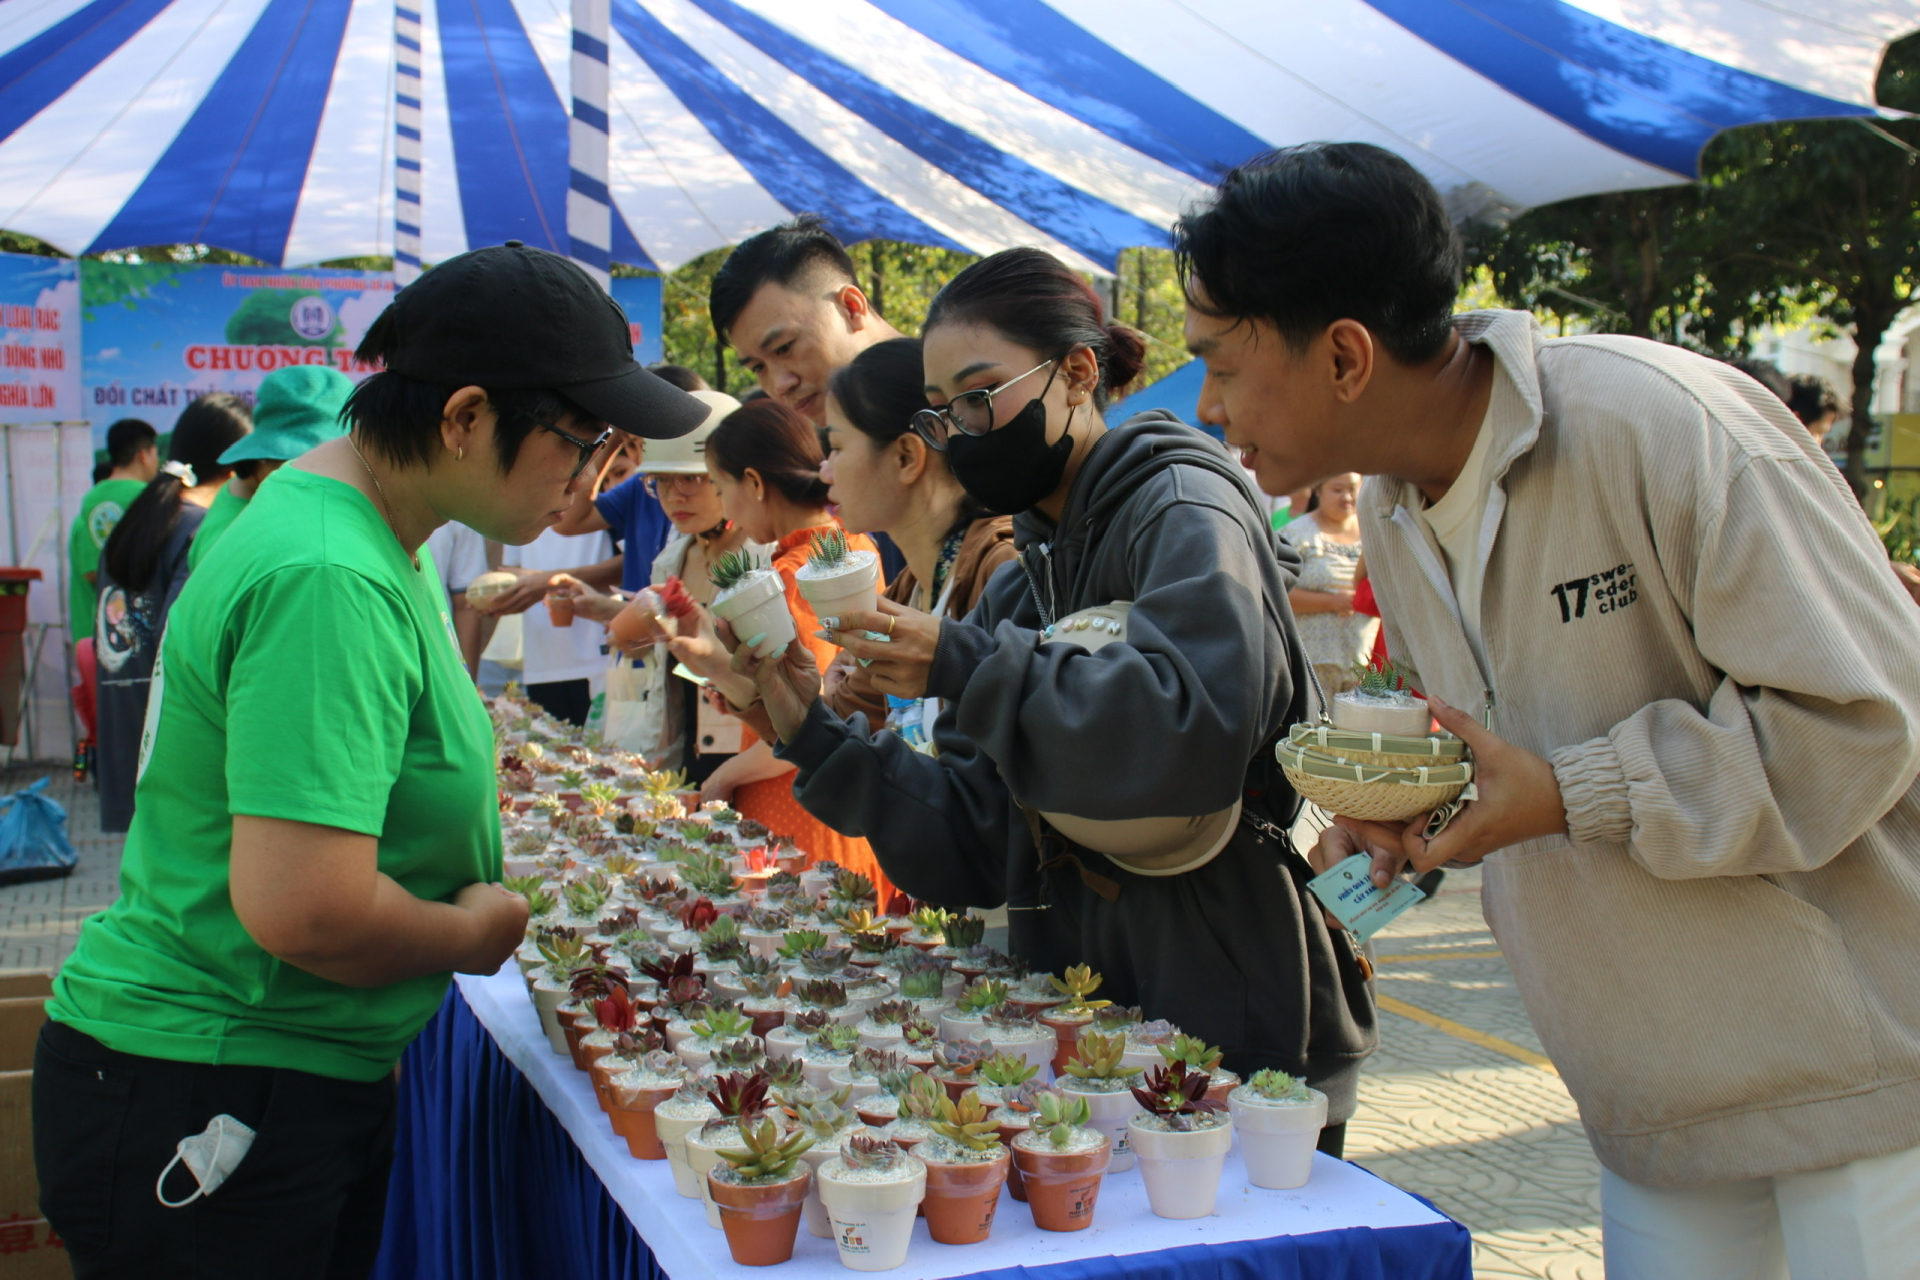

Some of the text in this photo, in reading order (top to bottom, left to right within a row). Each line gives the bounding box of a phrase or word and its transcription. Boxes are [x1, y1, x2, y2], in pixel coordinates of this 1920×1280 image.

[5, 303, 33, 333] LOẠI
[36, 303, 60, 331] RÁC
[5, 341, 37, 373] ĐỘNG
[132, 381, 177, 405] CHẤT
[1551, 563, 1634, 623] 17 swe-
[1595, 575, 1635, 600] eder
[1599, 589, 1637, 614] club
